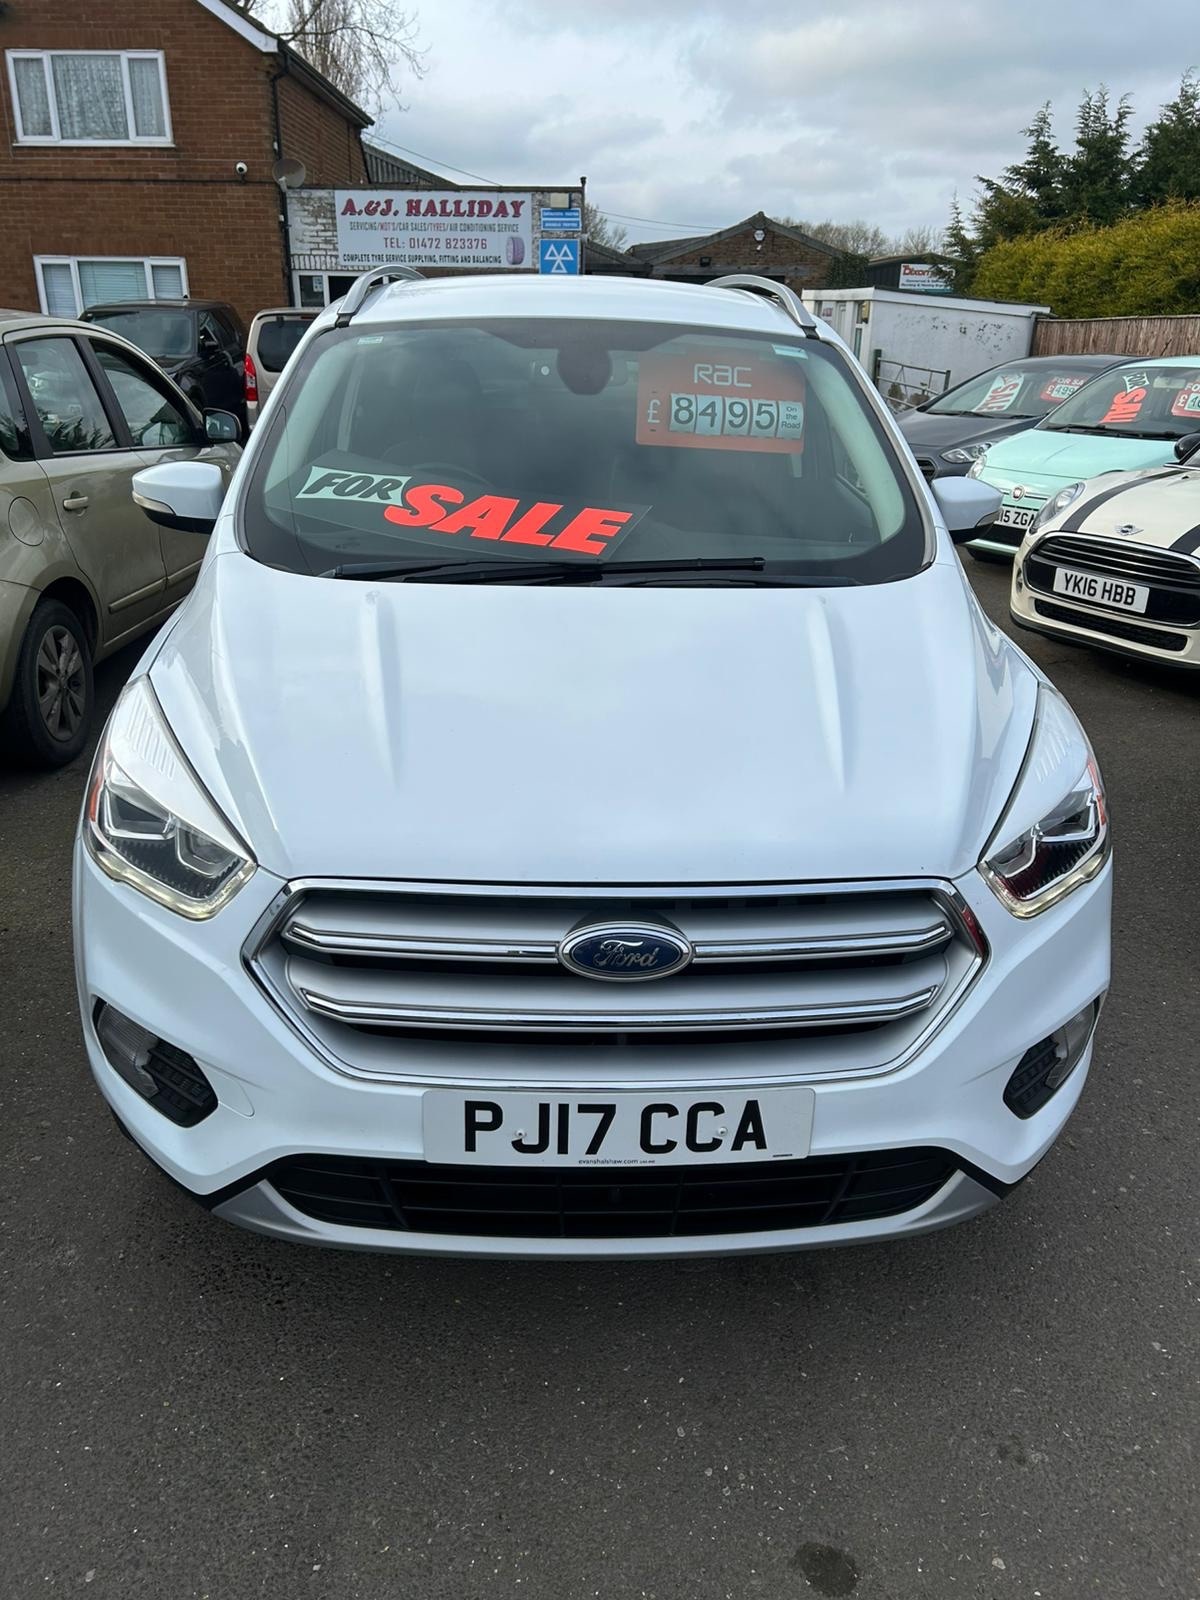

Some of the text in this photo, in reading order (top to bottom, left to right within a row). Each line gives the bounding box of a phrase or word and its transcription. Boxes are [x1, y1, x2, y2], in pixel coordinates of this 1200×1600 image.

[406, 199, 525, 218] HALLIDAY
[460, 223, 496, 232] CONDITIONING
[498, 224, 519, 232] SERVICE
[384, 237, 487, 250] TEL: 01472 823376
[344, 254, 370, 262] COMPLETE
[371, 254, 384, 262] TYRE
[386, 254, 407, 262] SERVICE
[439, 255, 459, 263] FITTING
[460, 255, 471, 263] AND
[472, 255, 502, 264] BALANCING
[1098, 386, 1147, 424] SAL
[781, 421, 801, 430] Road
[786, 413, 798, 421] the
[302, 472, 401, 500] FOR
[384, 484, 633, 555] SALE
[1064, 572, 1136, 606] YK16 HBB
[592, 939, 660, 967] Ford
[464, 1099, 767, 1155] PJ17 CCA
